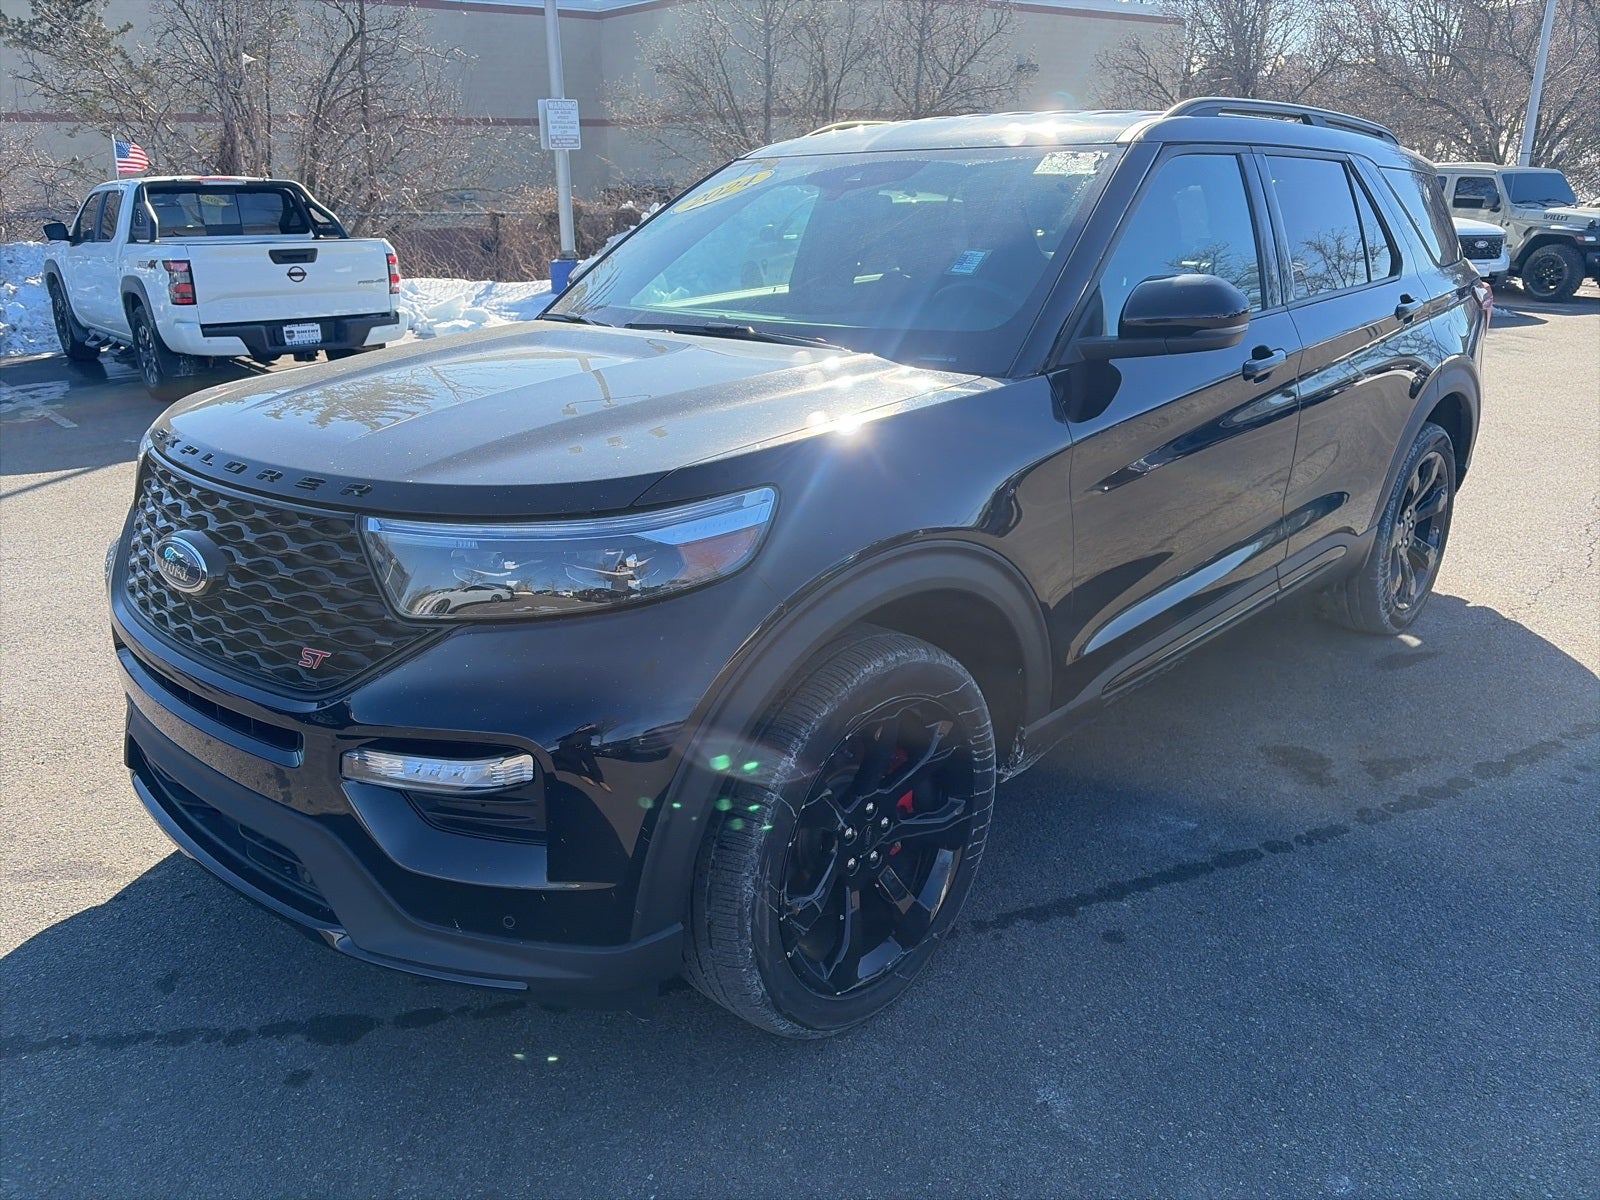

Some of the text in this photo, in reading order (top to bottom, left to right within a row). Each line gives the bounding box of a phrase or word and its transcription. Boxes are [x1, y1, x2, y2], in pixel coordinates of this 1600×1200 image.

[548, 101, 577, 110] WARNING
[154, 428, 374, 498] EXPLORER
[297, 647, 332, 670] ST
